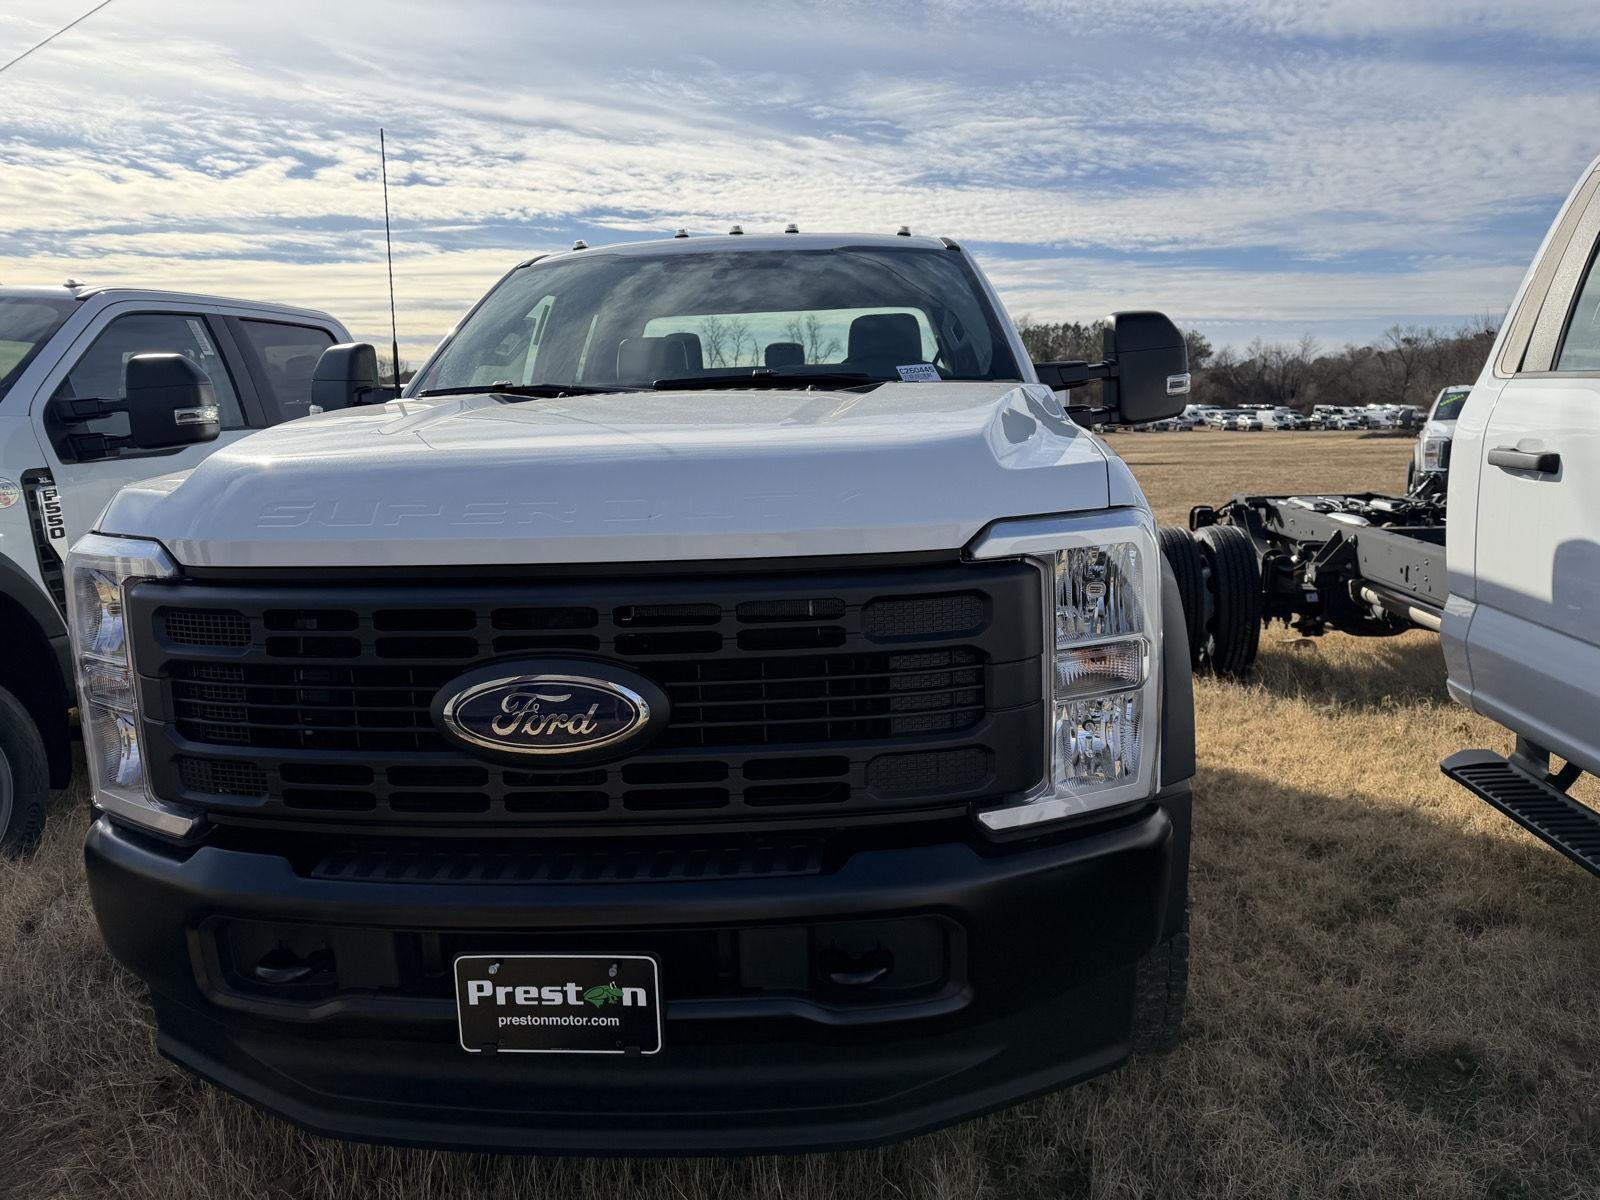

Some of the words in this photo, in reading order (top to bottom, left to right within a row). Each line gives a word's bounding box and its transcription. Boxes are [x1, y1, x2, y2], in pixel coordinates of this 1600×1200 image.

[255, 500, 578, 529] SUPER
[491, 692, 600, 736] Ford
[467, 979, 648, 1007] Prestn
[498, 1014, 620, 1028] prestonmotor.com
